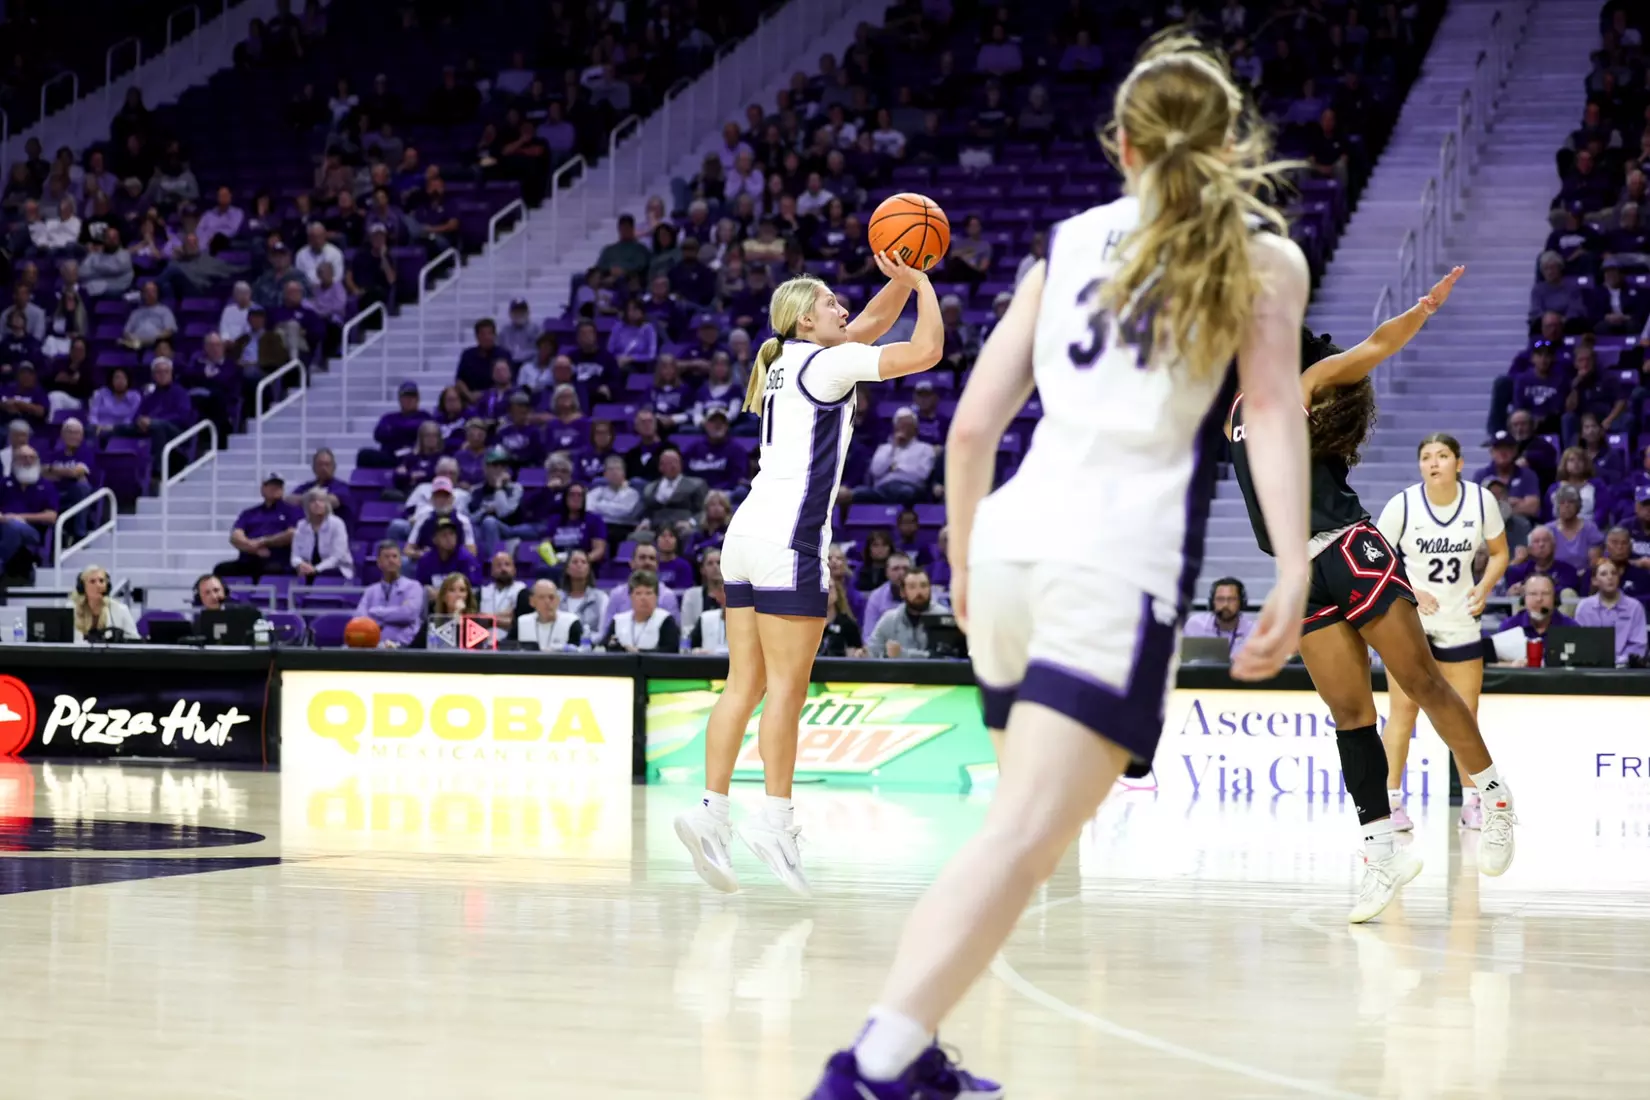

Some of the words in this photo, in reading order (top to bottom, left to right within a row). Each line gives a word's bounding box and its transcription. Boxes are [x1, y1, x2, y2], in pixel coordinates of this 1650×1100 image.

[1068, 277, 1167, 370] 34
[1416, 538, 1473, 554] Wildcats
[1428, 557, 1462, 584] 23
[42, 694, 157, 745] Pizza
[307, 690, 606, 755] QDOBA
[370, 743, 509, 762] MEXICAN
[524, 746, 601, 765] EATS
[1181, 754, 1253, 794] Via
